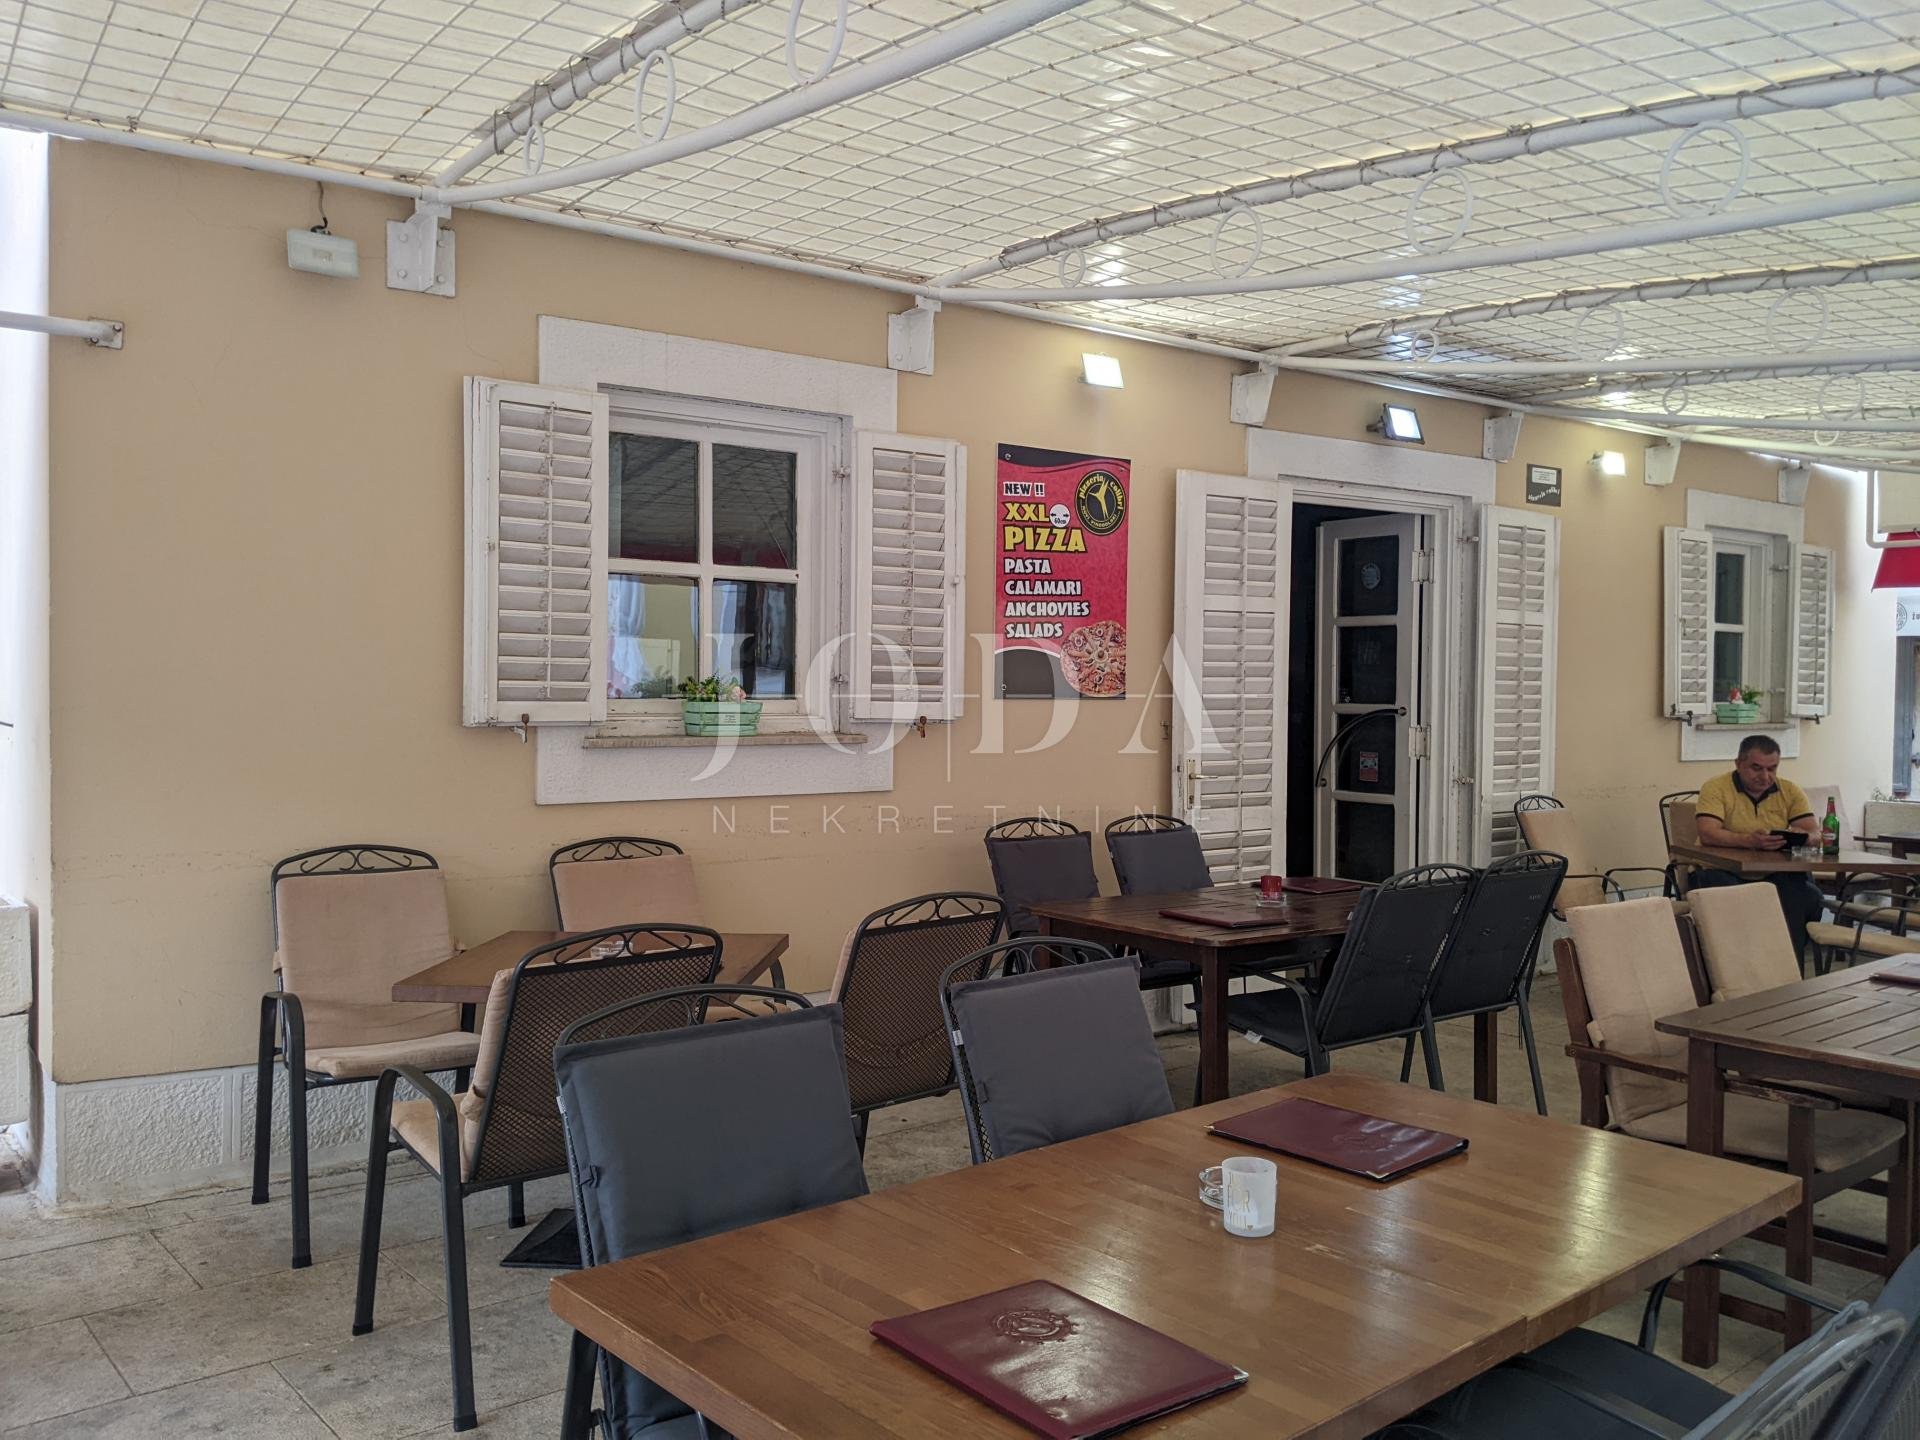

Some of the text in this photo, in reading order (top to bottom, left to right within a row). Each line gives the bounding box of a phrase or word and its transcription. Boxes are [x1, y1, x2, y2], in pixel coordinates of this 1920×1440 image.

[1004, 482, 1031, 496] NEW
[1004, 502, 1050, 522] XXL
[1003, 526, 1087, 552] PIZZA
[1004, 558, 1052, 574] PASTA
[1004, 580, 1082, 596] CALAMARI
[1005, 601, 1090, 617] ANCHOVIES
[1005, 623, 1063, 638] SALADS
